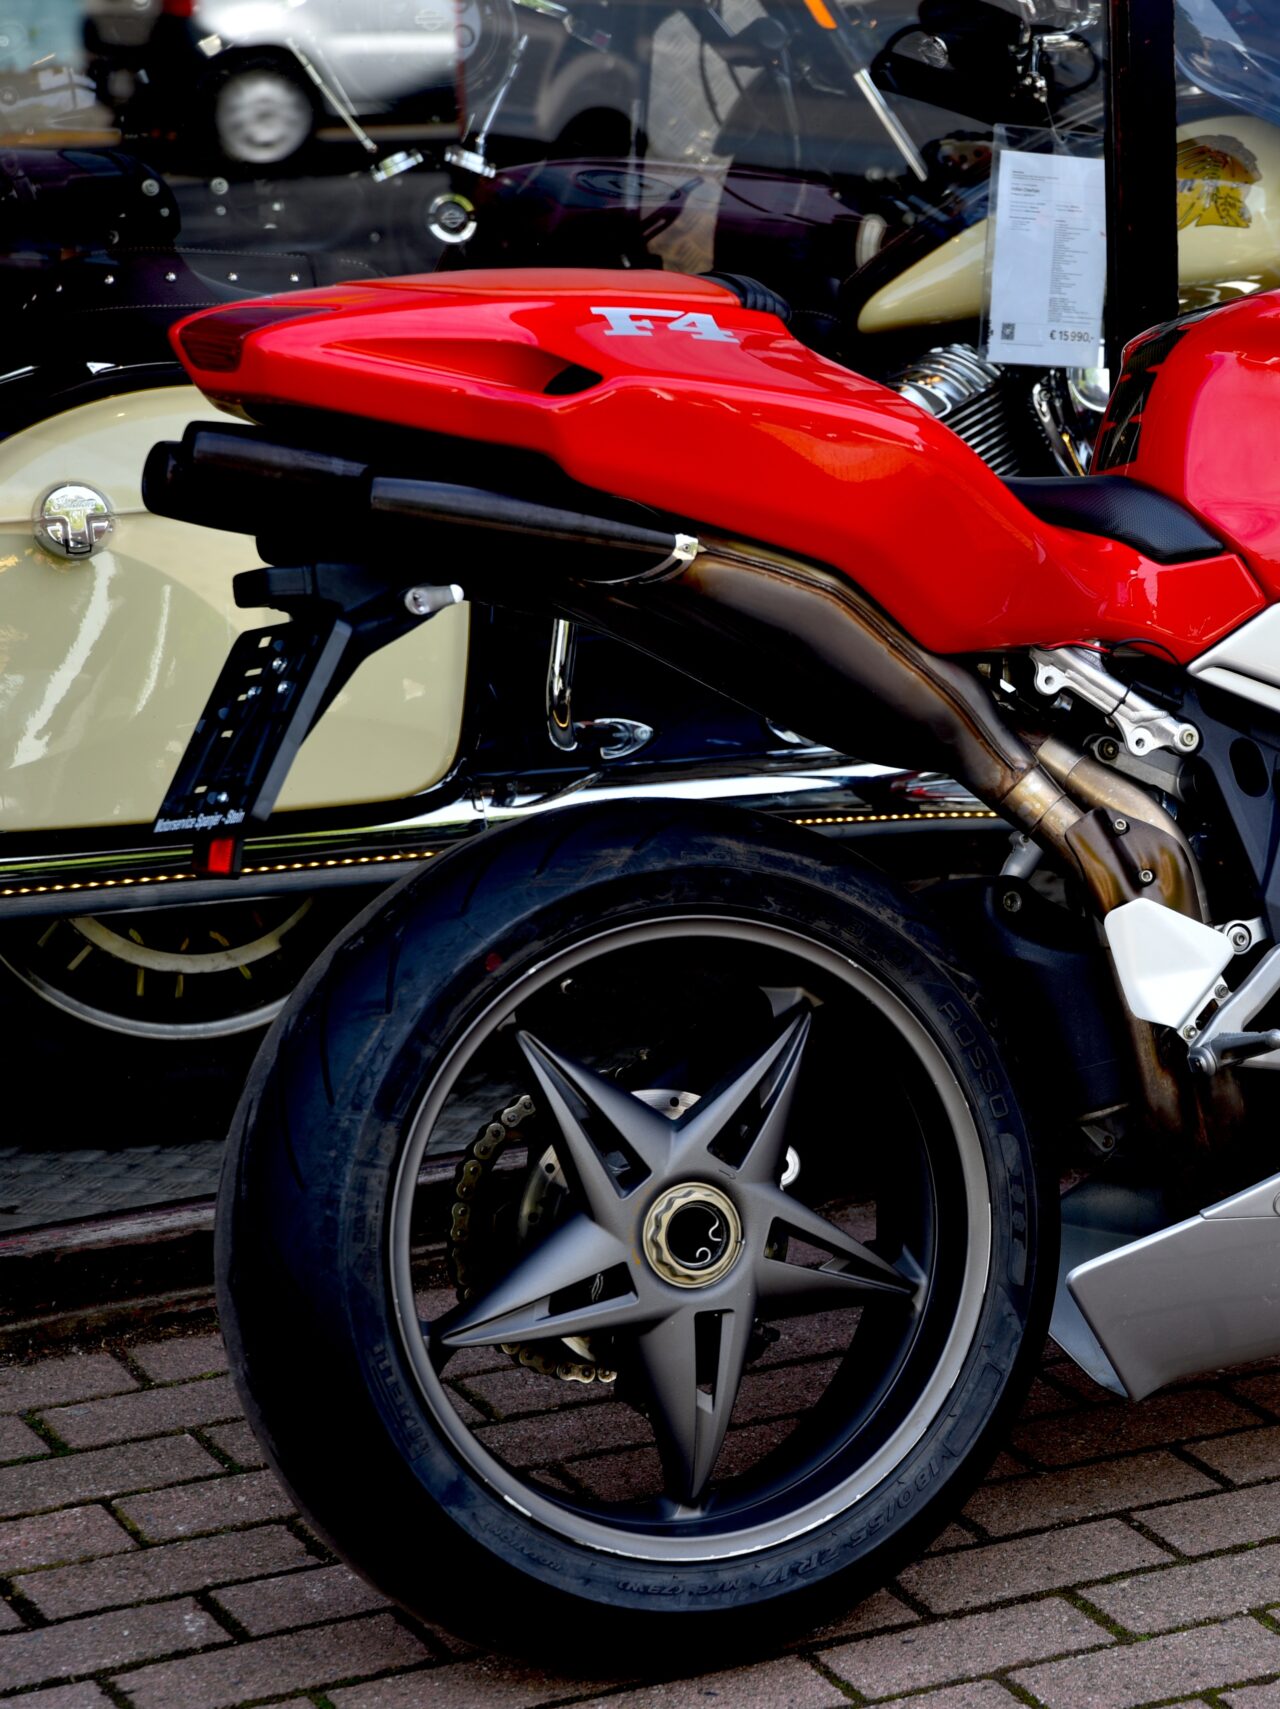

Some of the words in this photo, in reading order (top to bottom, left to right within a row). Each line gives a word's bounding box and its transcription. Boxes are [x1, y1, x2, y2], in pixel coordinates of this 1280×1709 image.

[590, 306, 740, 344] F4
[938, 1000, 1010, 1119] ROSSO
[850, 1457, 946, 1550] 180/55
